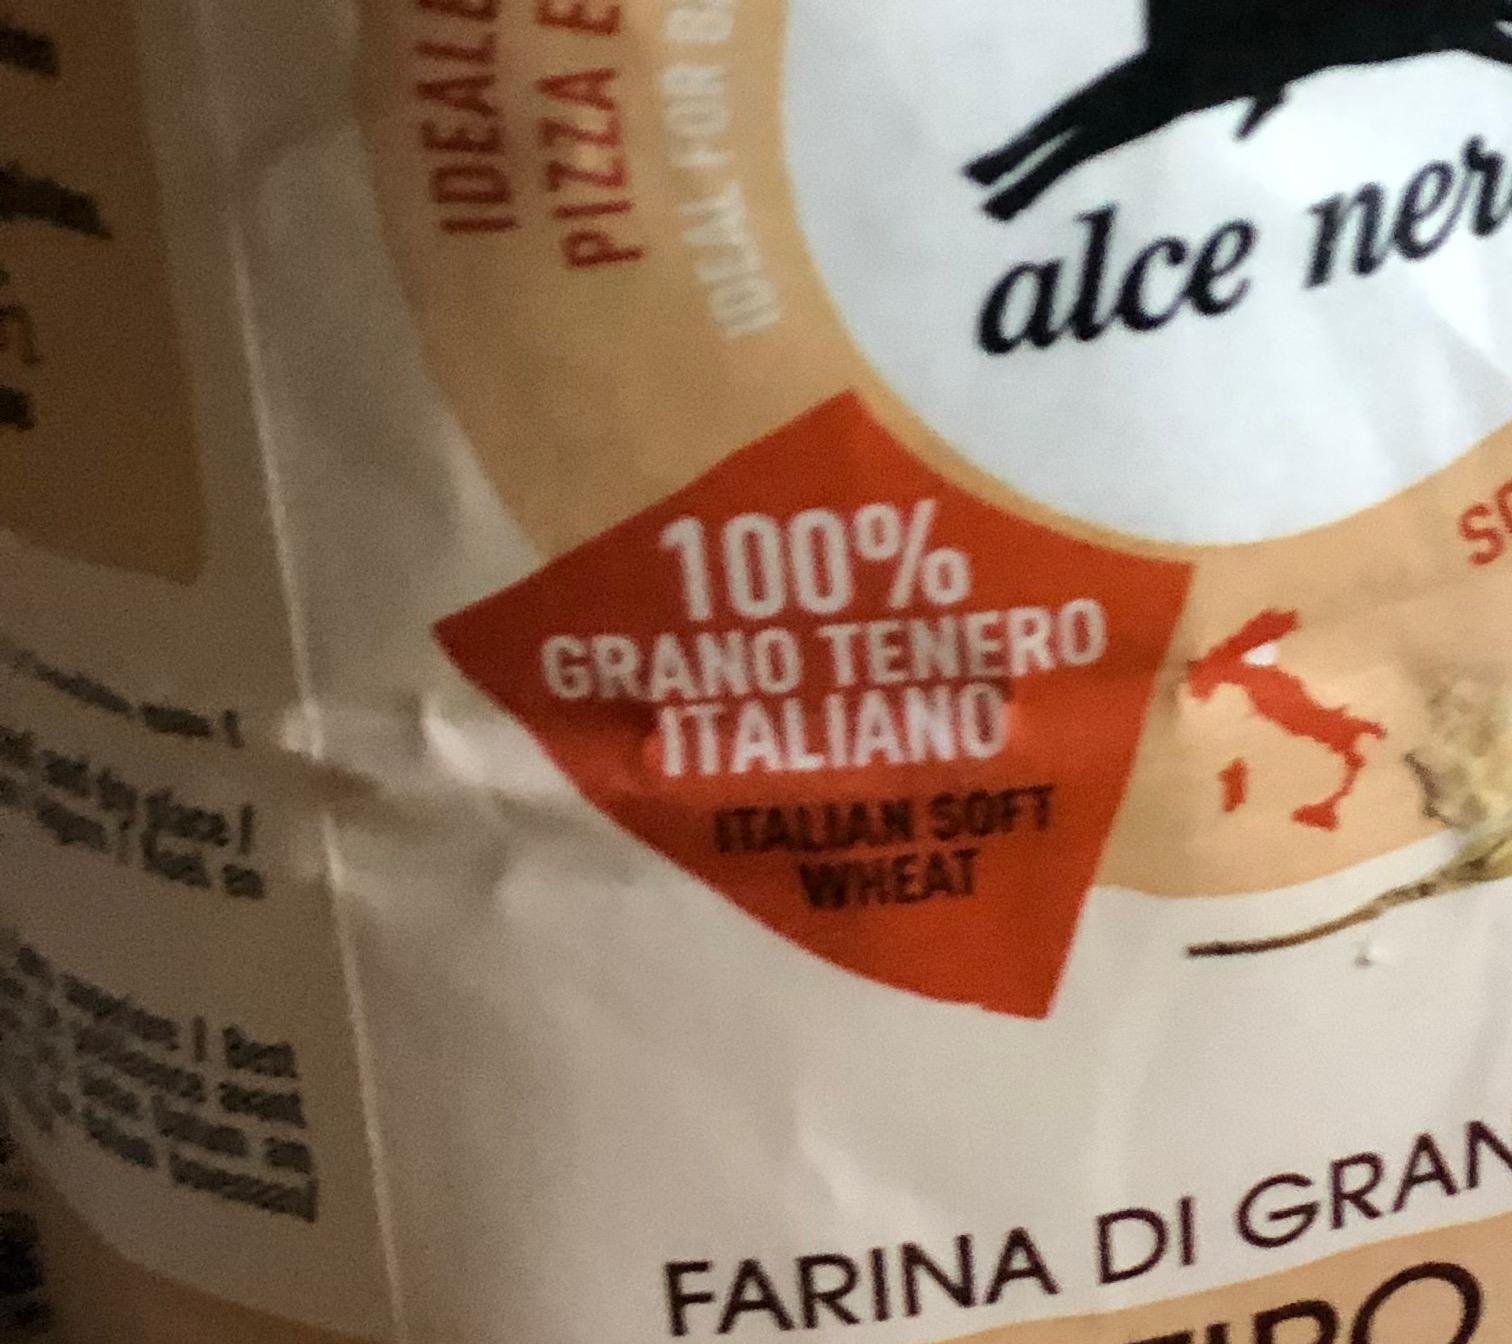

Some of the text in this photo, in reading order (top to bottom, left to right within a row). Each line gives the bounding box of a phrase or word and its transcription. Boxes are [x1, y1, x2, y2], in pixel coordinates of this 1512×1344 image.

[534, 67, 646, 270] PIZZA
[975, 203, 1257, 356] alce
[658, 498, 974, 623] 100%
[539, 598, 1109, 706] GRANO TENERO
[654, 680, 1010, 779] ITALIANO
[711, 783, 1057, 856] ITALIAN SOFT
[796, 846, 984, 911] WHEAT
[663, 1225, 1063, 1338] FARINA
[1094, 1193, 1197, 1287] DI
